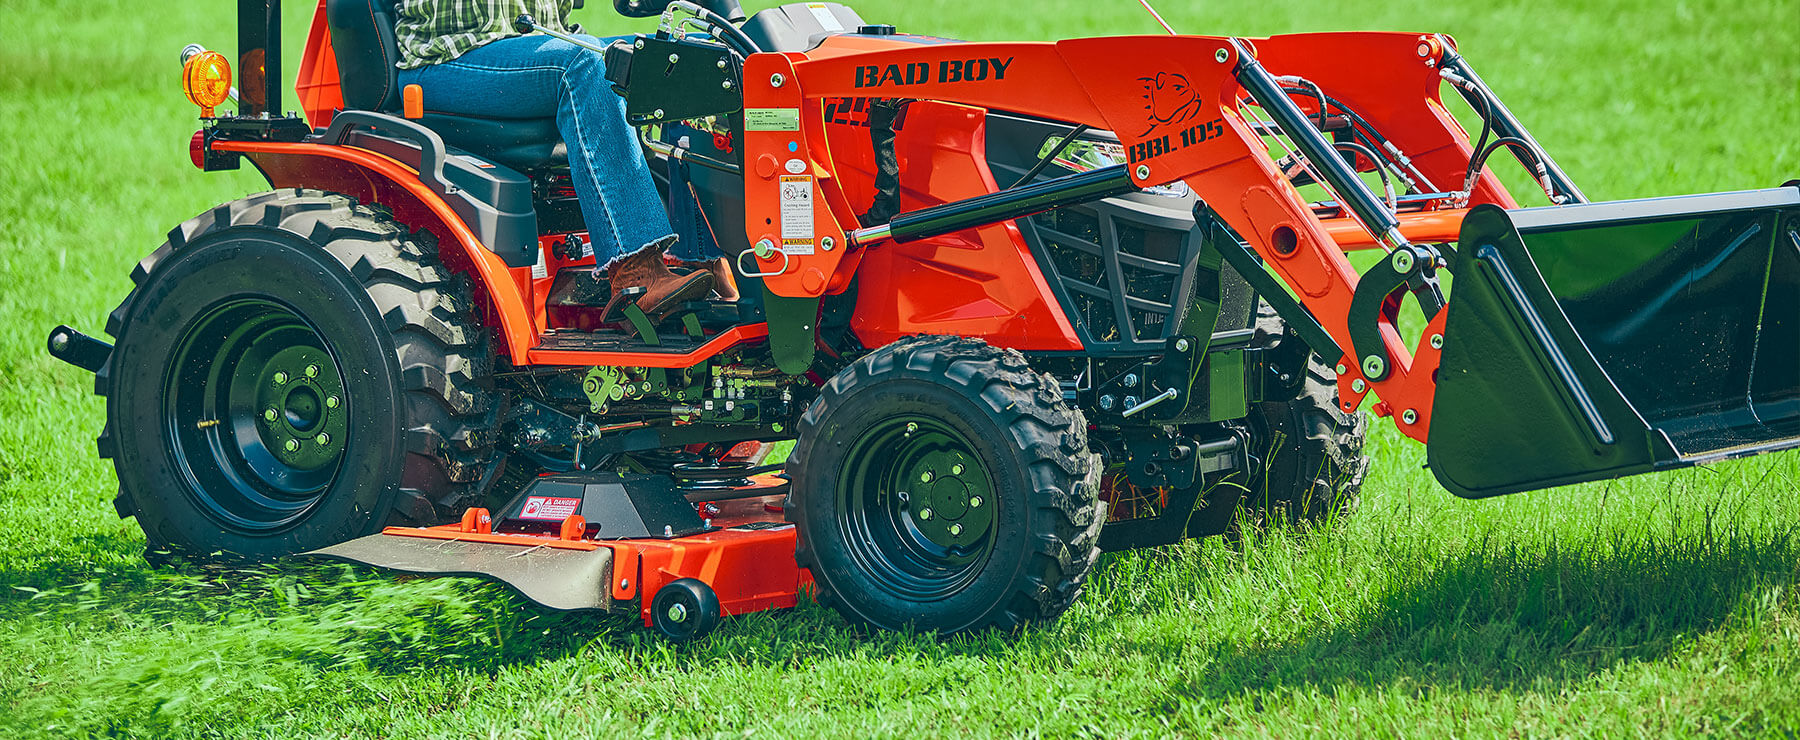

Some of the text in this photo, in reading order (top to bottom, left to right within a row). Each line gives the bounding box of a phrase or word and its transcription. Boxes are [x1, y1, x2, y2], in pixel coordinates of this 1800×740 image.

[855, 57, 1014, 88] BAD BOY
[1129, 118, 1223, 164] BBL 105
